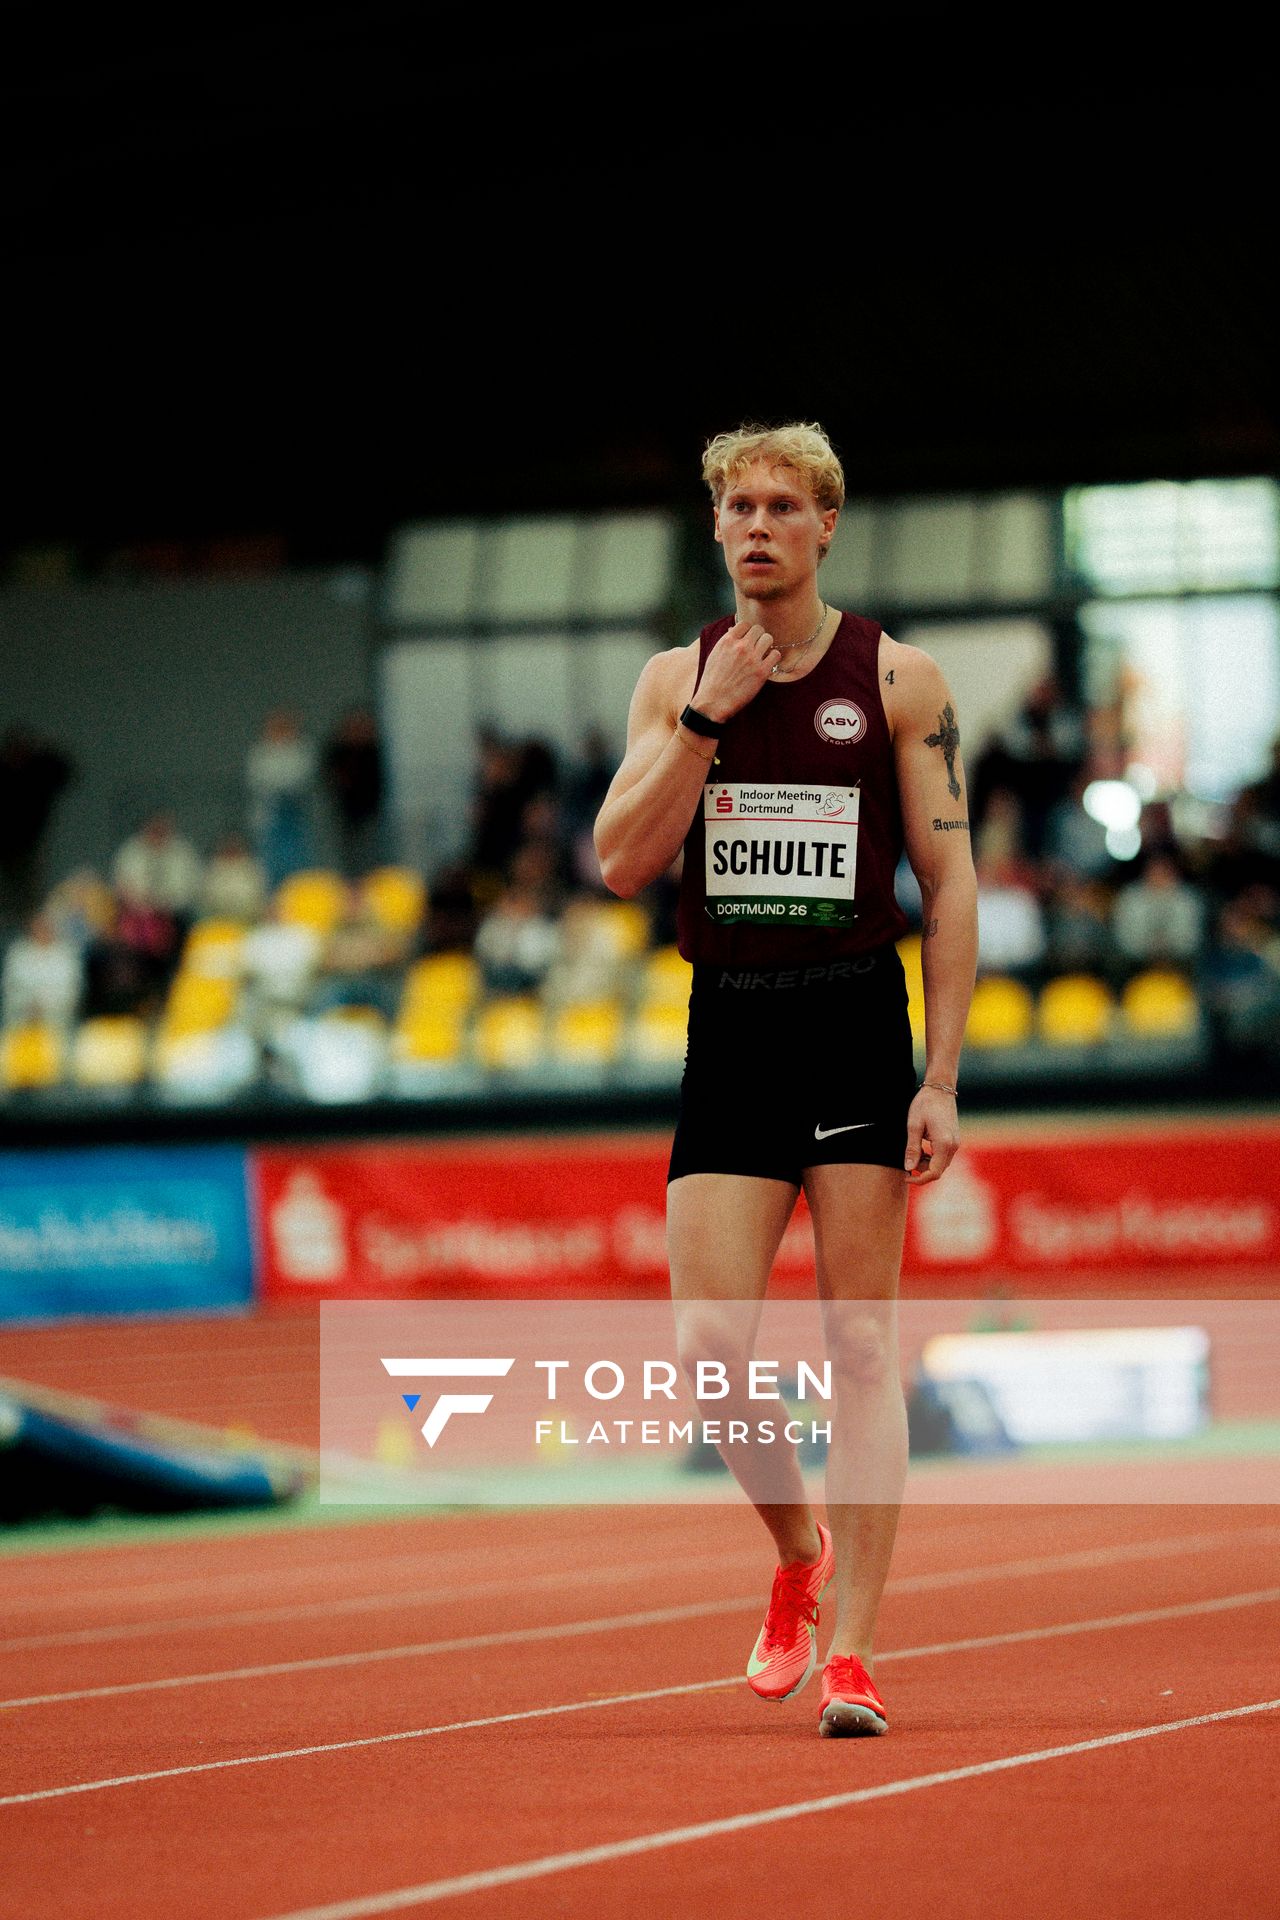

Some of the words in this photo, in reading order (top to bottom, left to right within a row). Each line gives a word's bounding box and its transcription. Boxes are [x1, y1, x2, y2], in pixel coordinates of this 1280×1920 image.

[885, 670, 895, 685] 4
[823, 717, 858, 727] ASV
[740, 790, 774, 800] Indoor
[777, 790, 822, 803] Meeting
[739, 804, 794, 814] Dortmund
[713, 840, 847, 878] SCHULTE
[717, 904, 786, 915] DORTMUND
[788, 905, 808, 916] 26
[718, 971, 799, 990] NIKE
[803, 956, 876, 986] PRO
